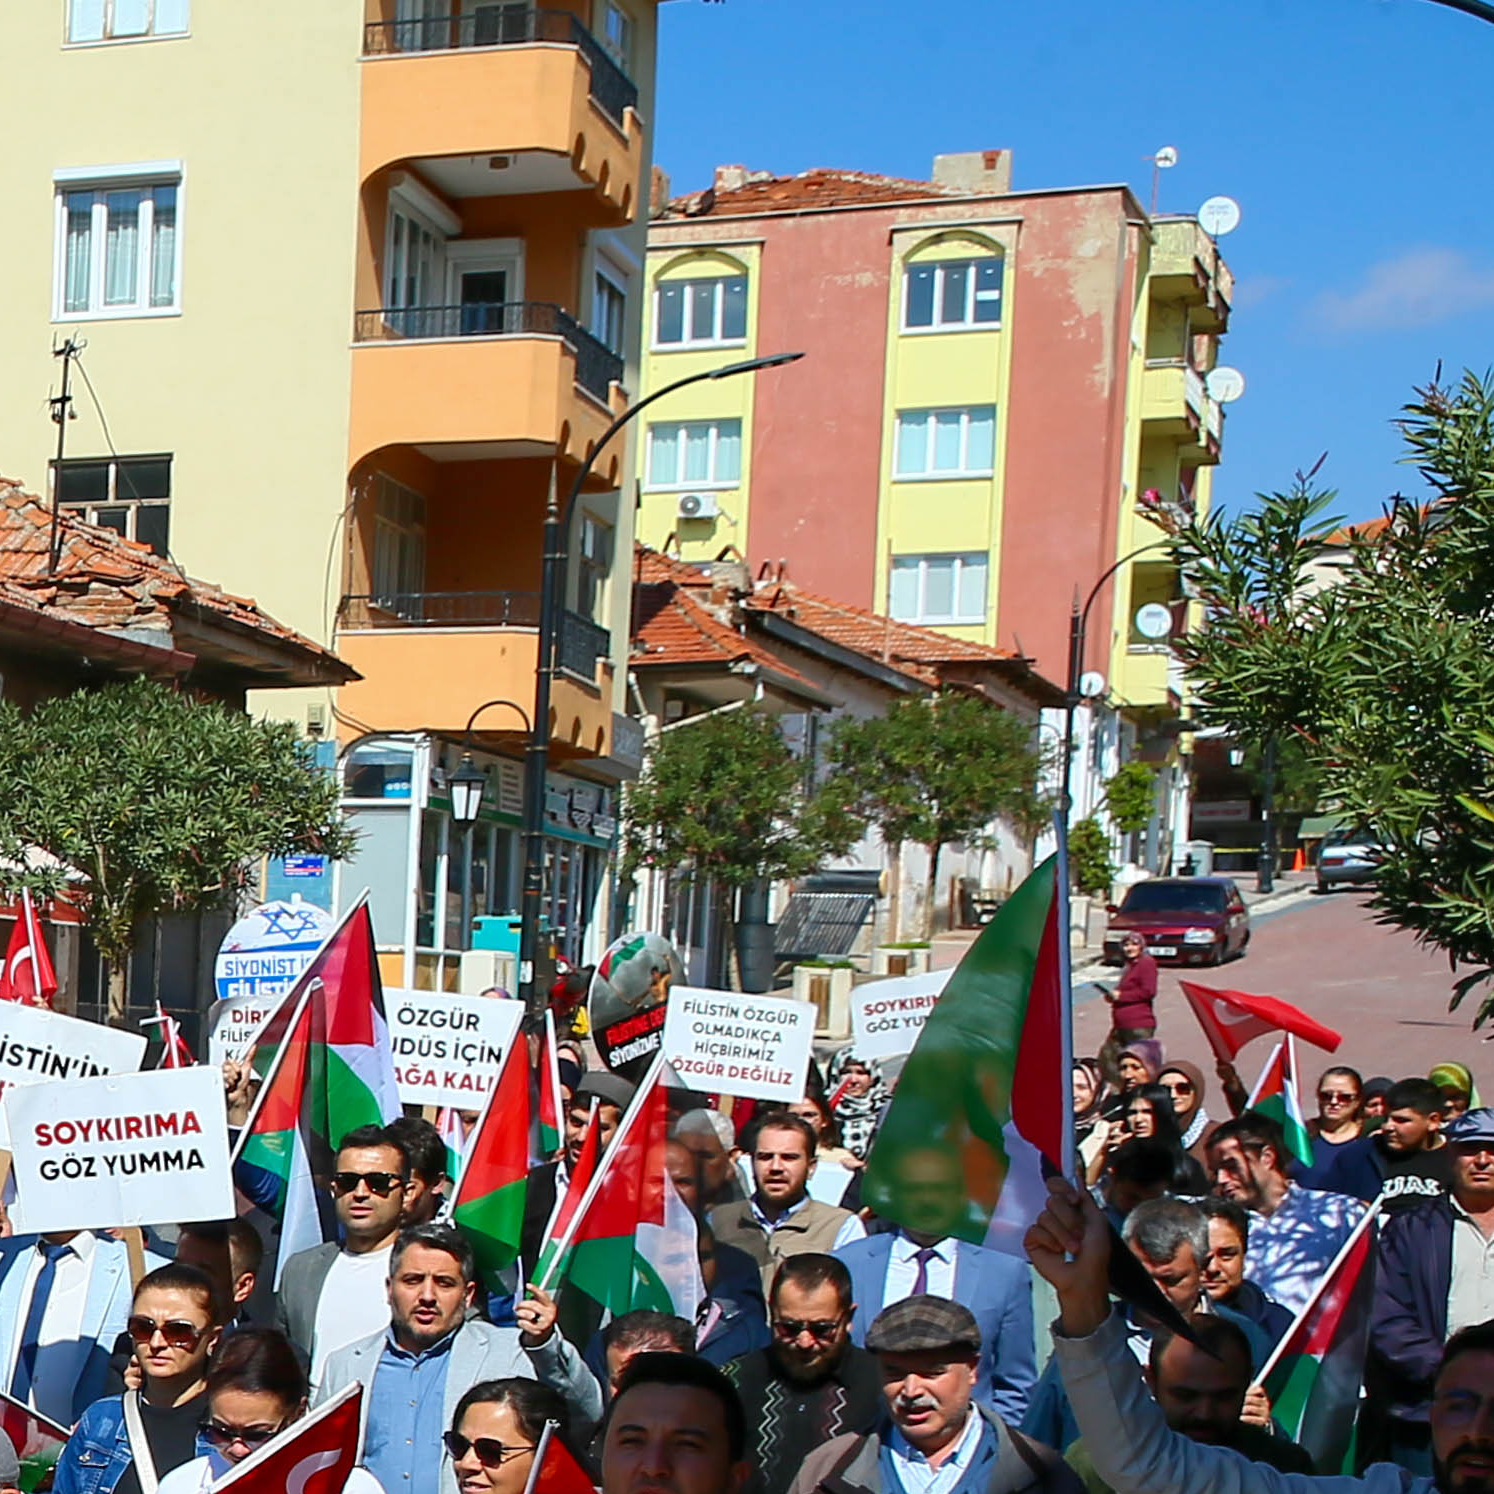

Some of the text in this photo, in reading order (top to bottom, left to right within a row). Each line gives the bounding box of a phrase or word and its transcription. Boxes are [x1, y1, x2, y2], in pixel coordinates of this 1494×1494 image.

[224, 953, 296, 977] SİYONİST
[397, 1002, 480, 1032] ÖZGÜR
[682, 1000, 799, 1027] FİLİSTİN ÖZGÜR
[692, 1020, 783, 1045] OLMADIKÇA
[453, 1037, 502, 1067] İÇİN
[670, 1057, 794, 1086] ÖZGÜR DEĞİLİZ
[35, 1111, 202, 1146] SOYKIRIMA
[40, 1149, 205, 1181] GÖZ YUMMA
